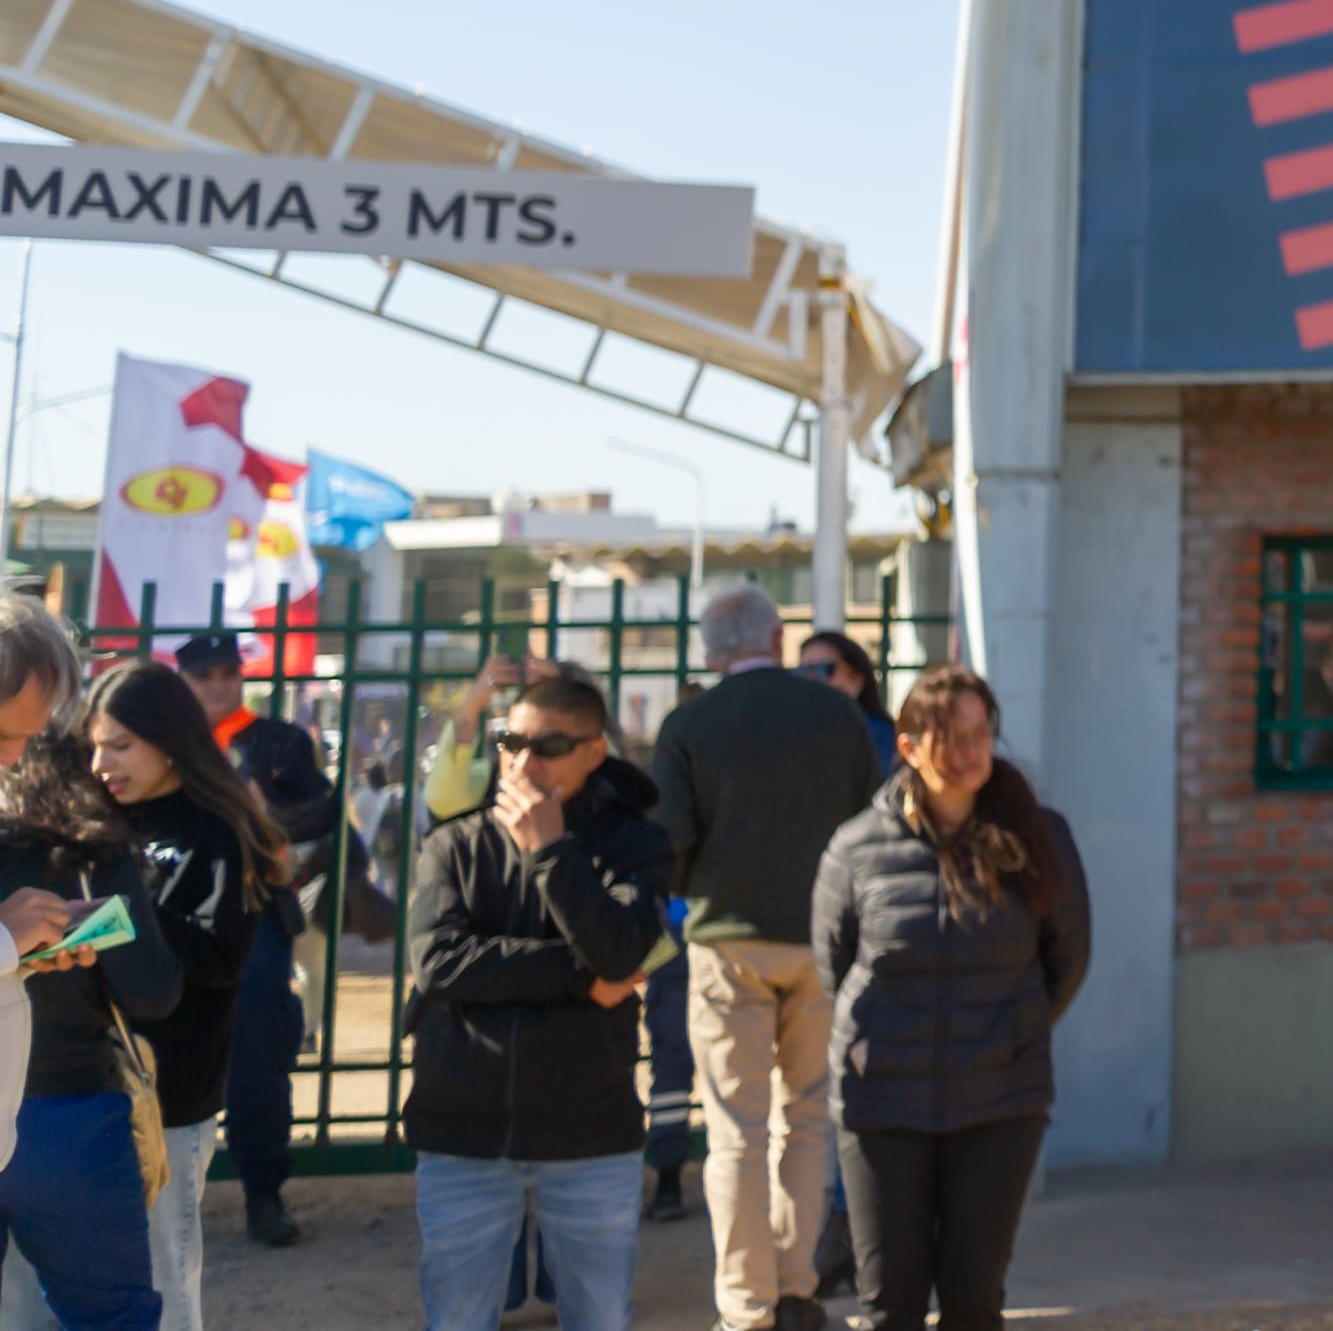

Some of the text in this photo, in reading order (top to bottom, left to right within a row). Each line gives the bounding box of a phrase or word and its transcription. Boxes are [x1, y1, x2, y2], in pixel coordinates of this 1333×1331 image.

[0, 167, 576, 247] MAXIMA 3 MTS.
